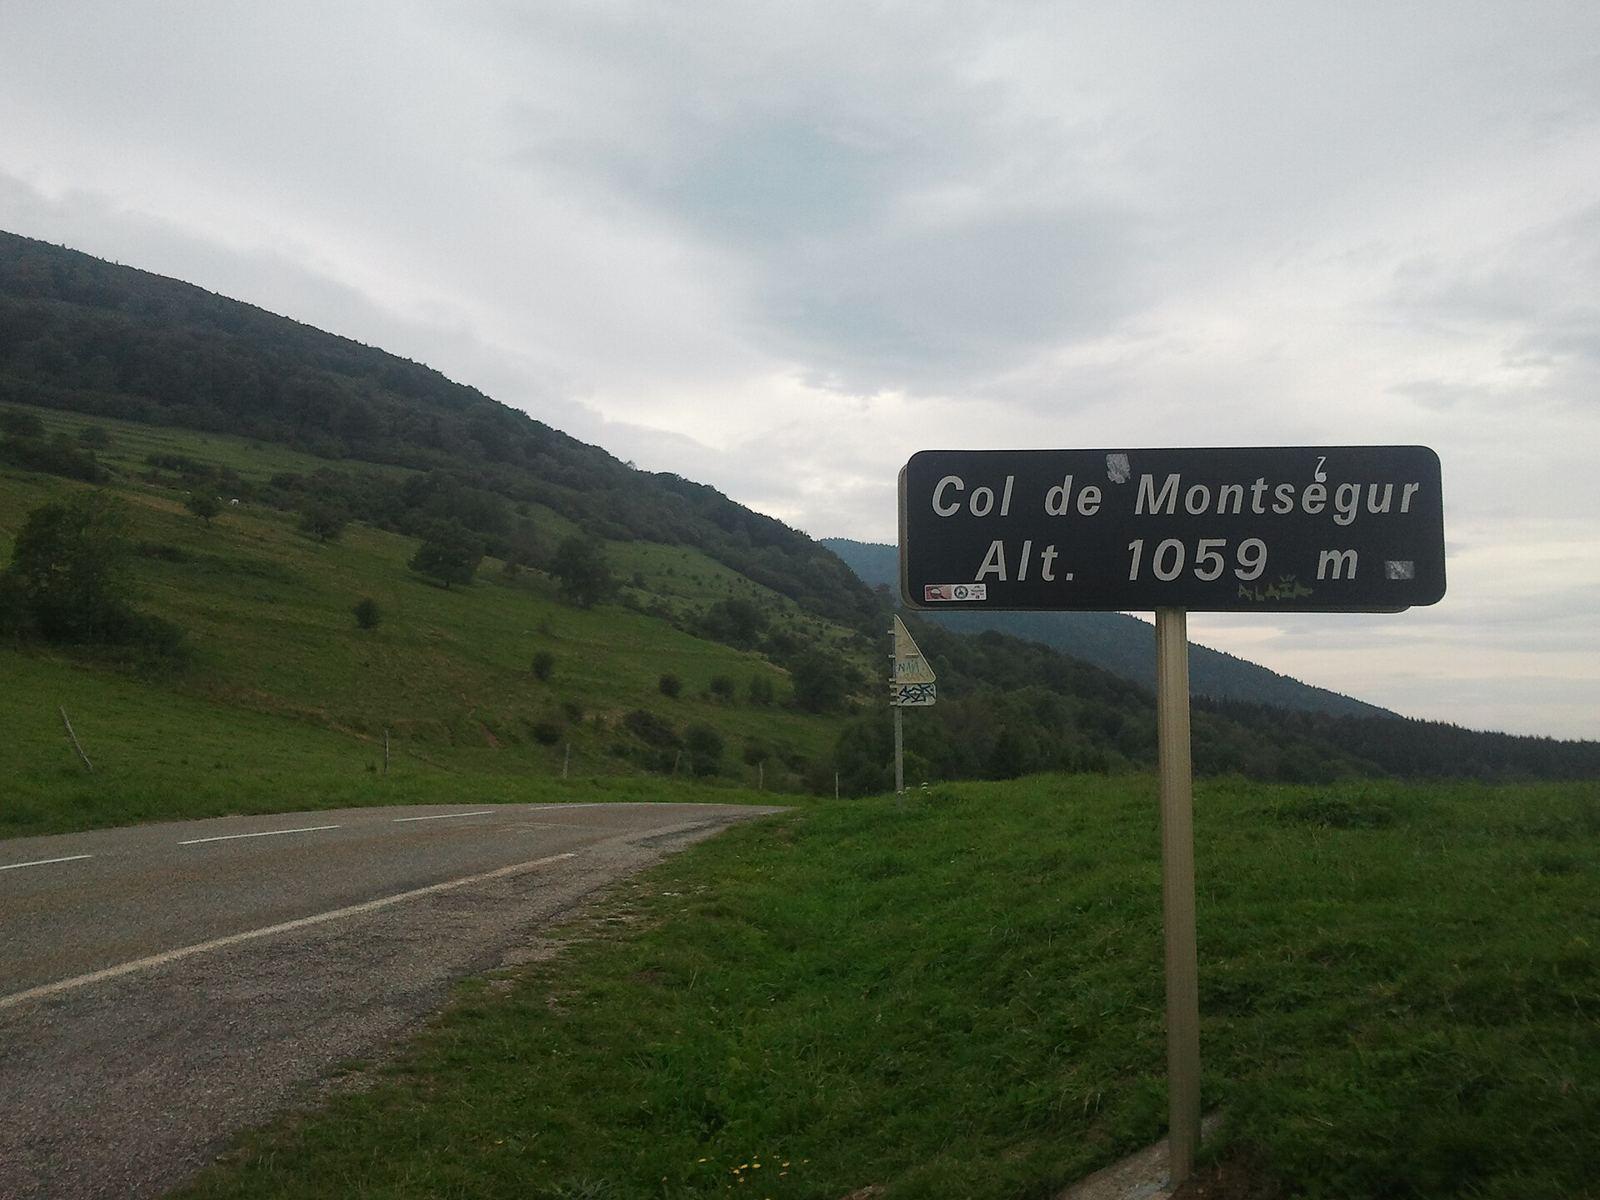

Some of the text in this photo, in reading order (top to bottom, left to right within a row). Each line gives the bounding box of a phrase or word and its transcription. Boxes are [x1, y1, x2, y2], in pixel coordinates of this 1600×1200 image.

[931, 474, 1015, 517] Col
[1044, 474, 1103, 516] de
[974, 538, 1359, 582] Alt. 1059 m
